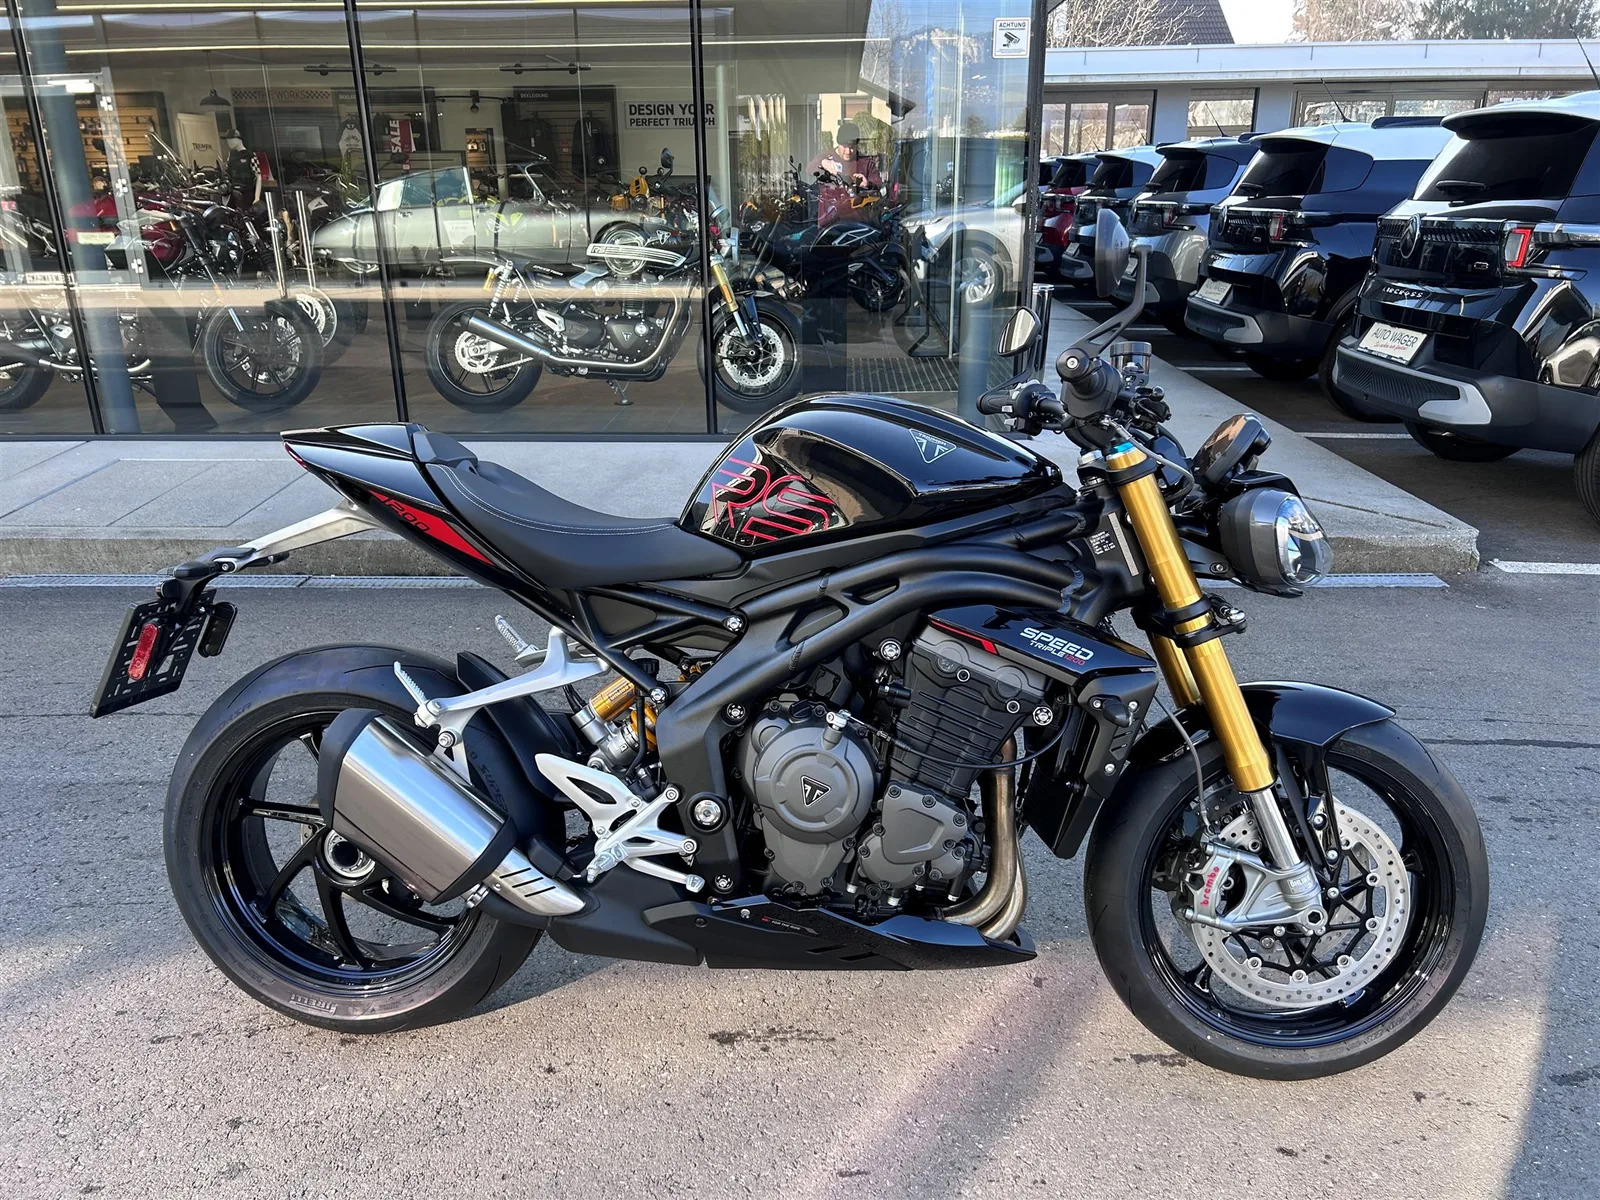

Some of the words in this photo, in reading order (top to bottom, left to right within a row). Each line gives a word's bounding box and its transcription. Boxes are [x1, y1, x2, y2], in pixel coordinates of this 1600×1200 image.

[276, 89, 306, 100] WORKS
[628, 104, 675, 116] DESIGN
[679, 103, 715, 115] YOR
[629, 117, 671, 127] PERFECT
[673, 117, 716, 126] TRIUPH
[389, 119, 402, 153] SALE
[1371, 327, 1392, 341] AUTO
[1390, 330, 1419, 348] WÄGER
[711, 457, 836, 541] RS
[1020, 627, 1095, 661] SPEED
[1029, 640, 1066, 658] TRIPLE
[1064, 653, 1086, 666] 1200
[1200, 866, 1220, 907] brembo
[290, 992, 338, 1015] PIRELLI
